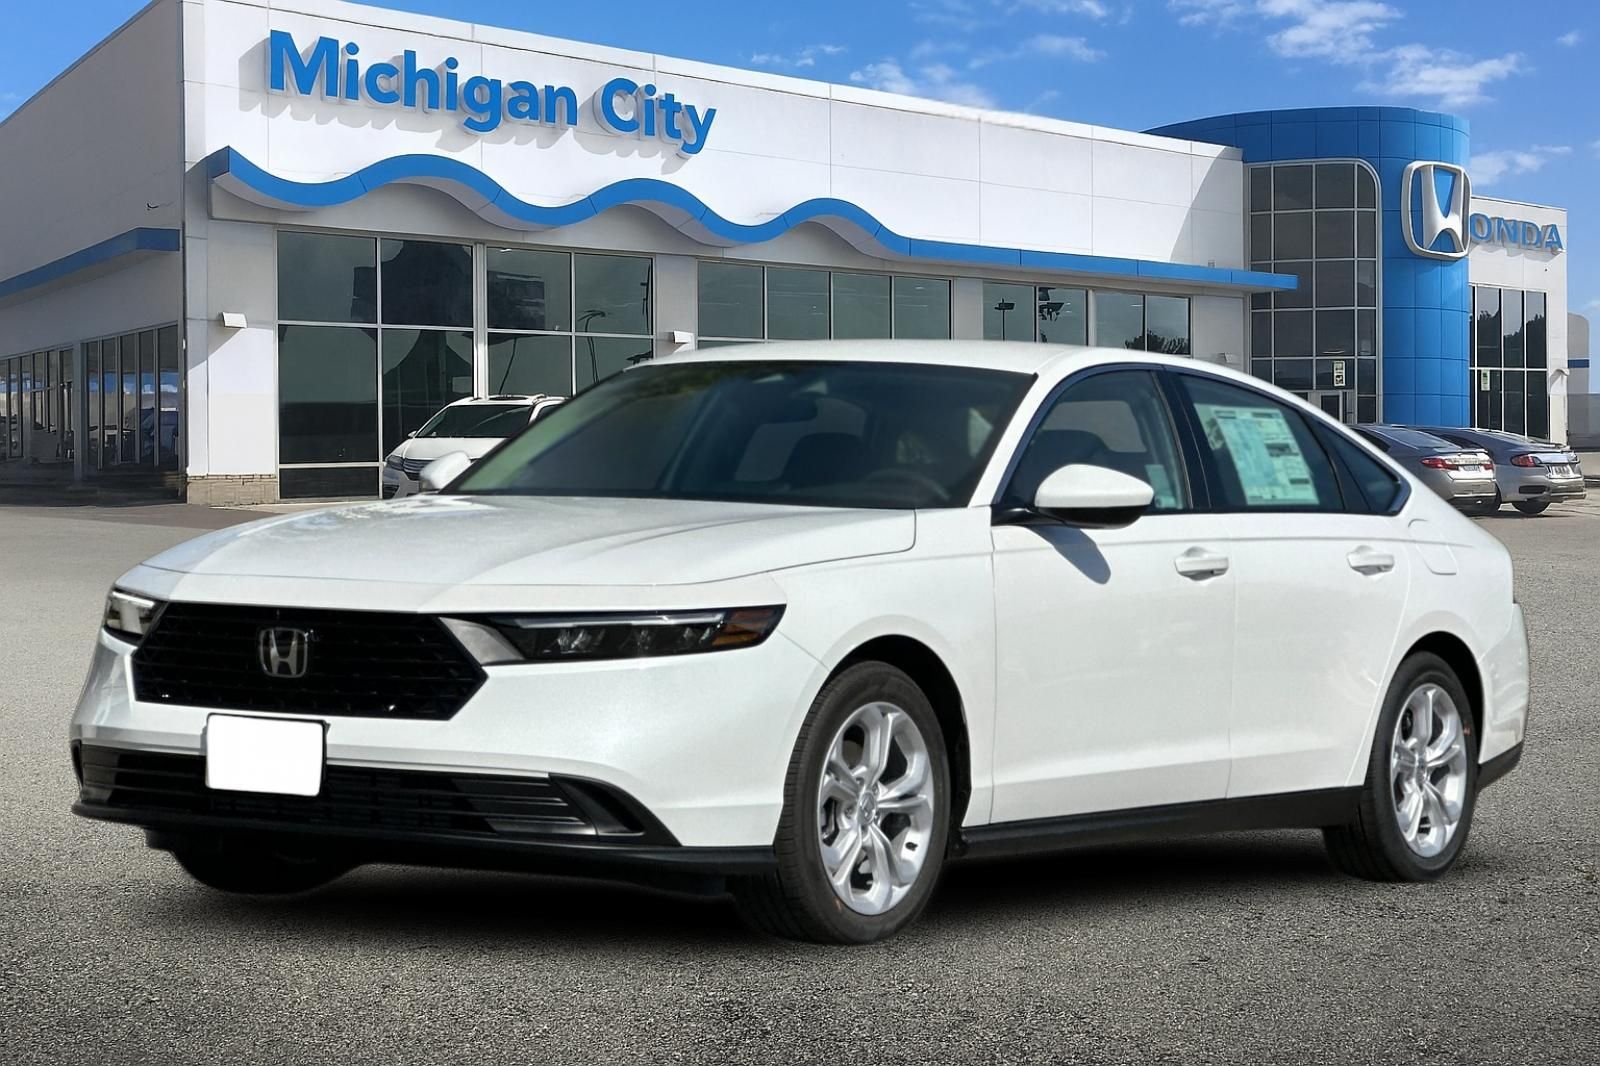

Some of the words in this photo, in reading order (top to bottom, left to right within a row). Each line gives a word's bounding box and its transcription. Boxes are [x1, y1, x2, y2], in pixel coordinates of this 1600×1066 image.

[269, 29, 578, 133] Michigan
[600, 77, 718, 155] City
[1469, 212, 1564, 250] ONDA
